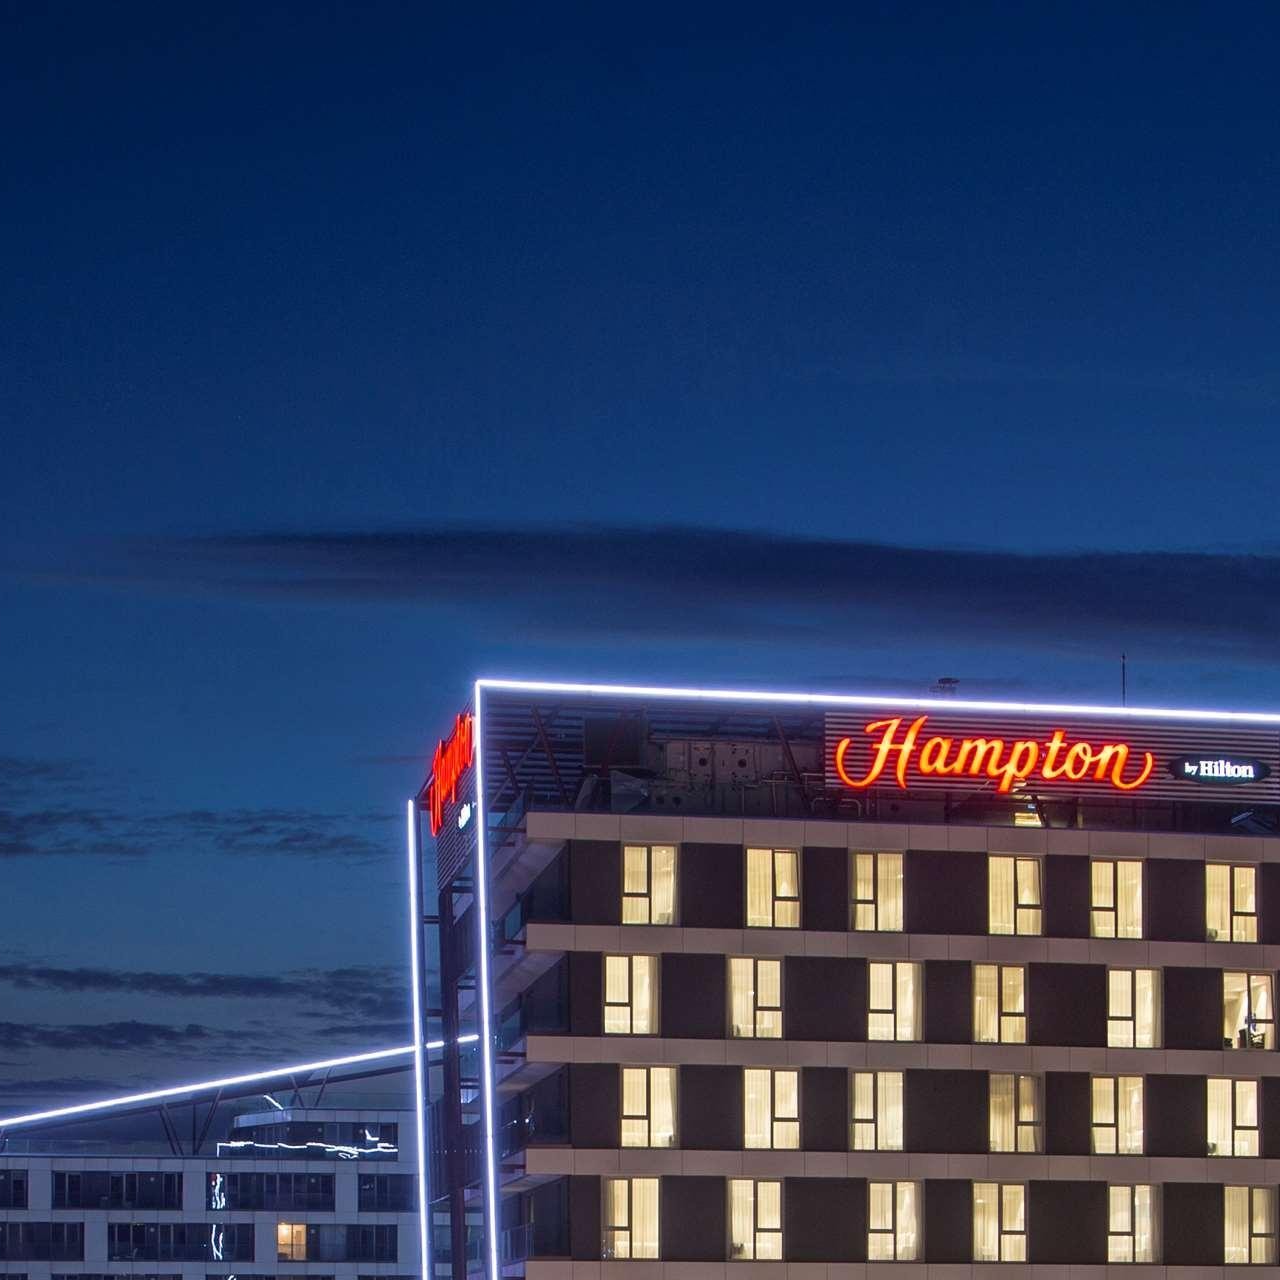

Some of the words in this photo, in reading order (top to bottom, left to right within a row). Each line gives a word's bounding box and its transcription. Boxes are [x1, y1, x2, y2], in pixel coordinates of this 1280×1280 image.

[836, 716, 1153, 793] Hampton
[1184, 762, 1198, 775] by
[1200, 760, 1254, 777] Hilton
